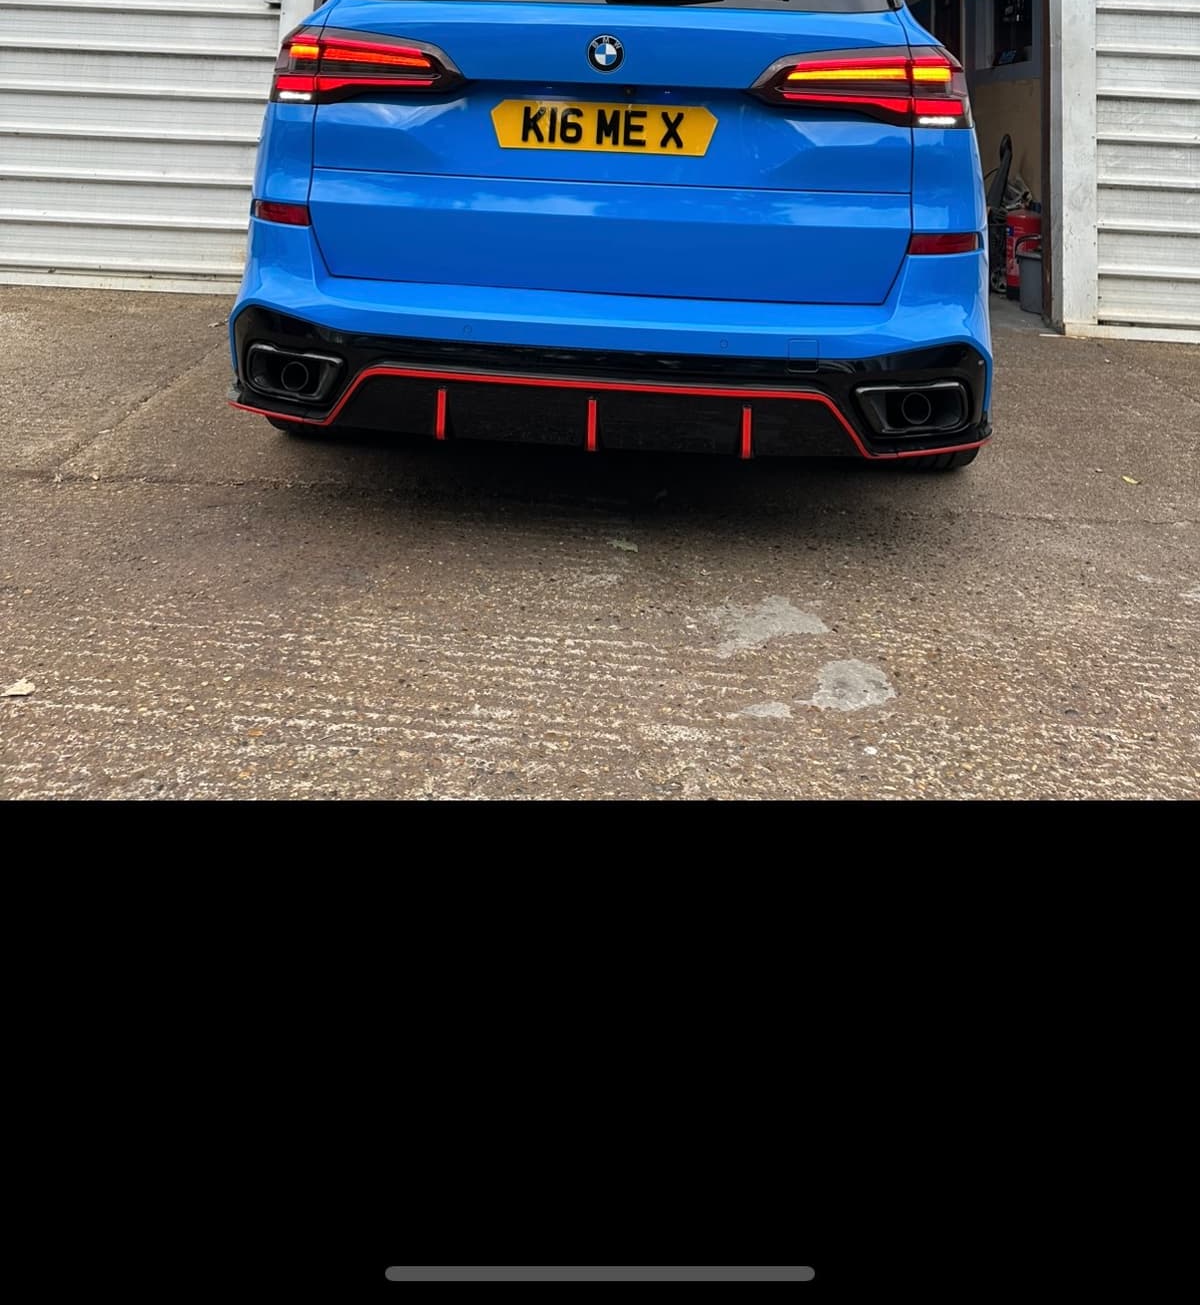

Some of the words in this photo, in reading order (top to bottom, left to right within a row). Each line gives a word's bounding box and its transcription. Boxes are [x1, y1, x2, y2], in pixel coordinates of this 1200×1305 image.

[521, 106, 584, 143] K16
[595, 109, 648, 146] ME
[660, 112, 684, 148] X
